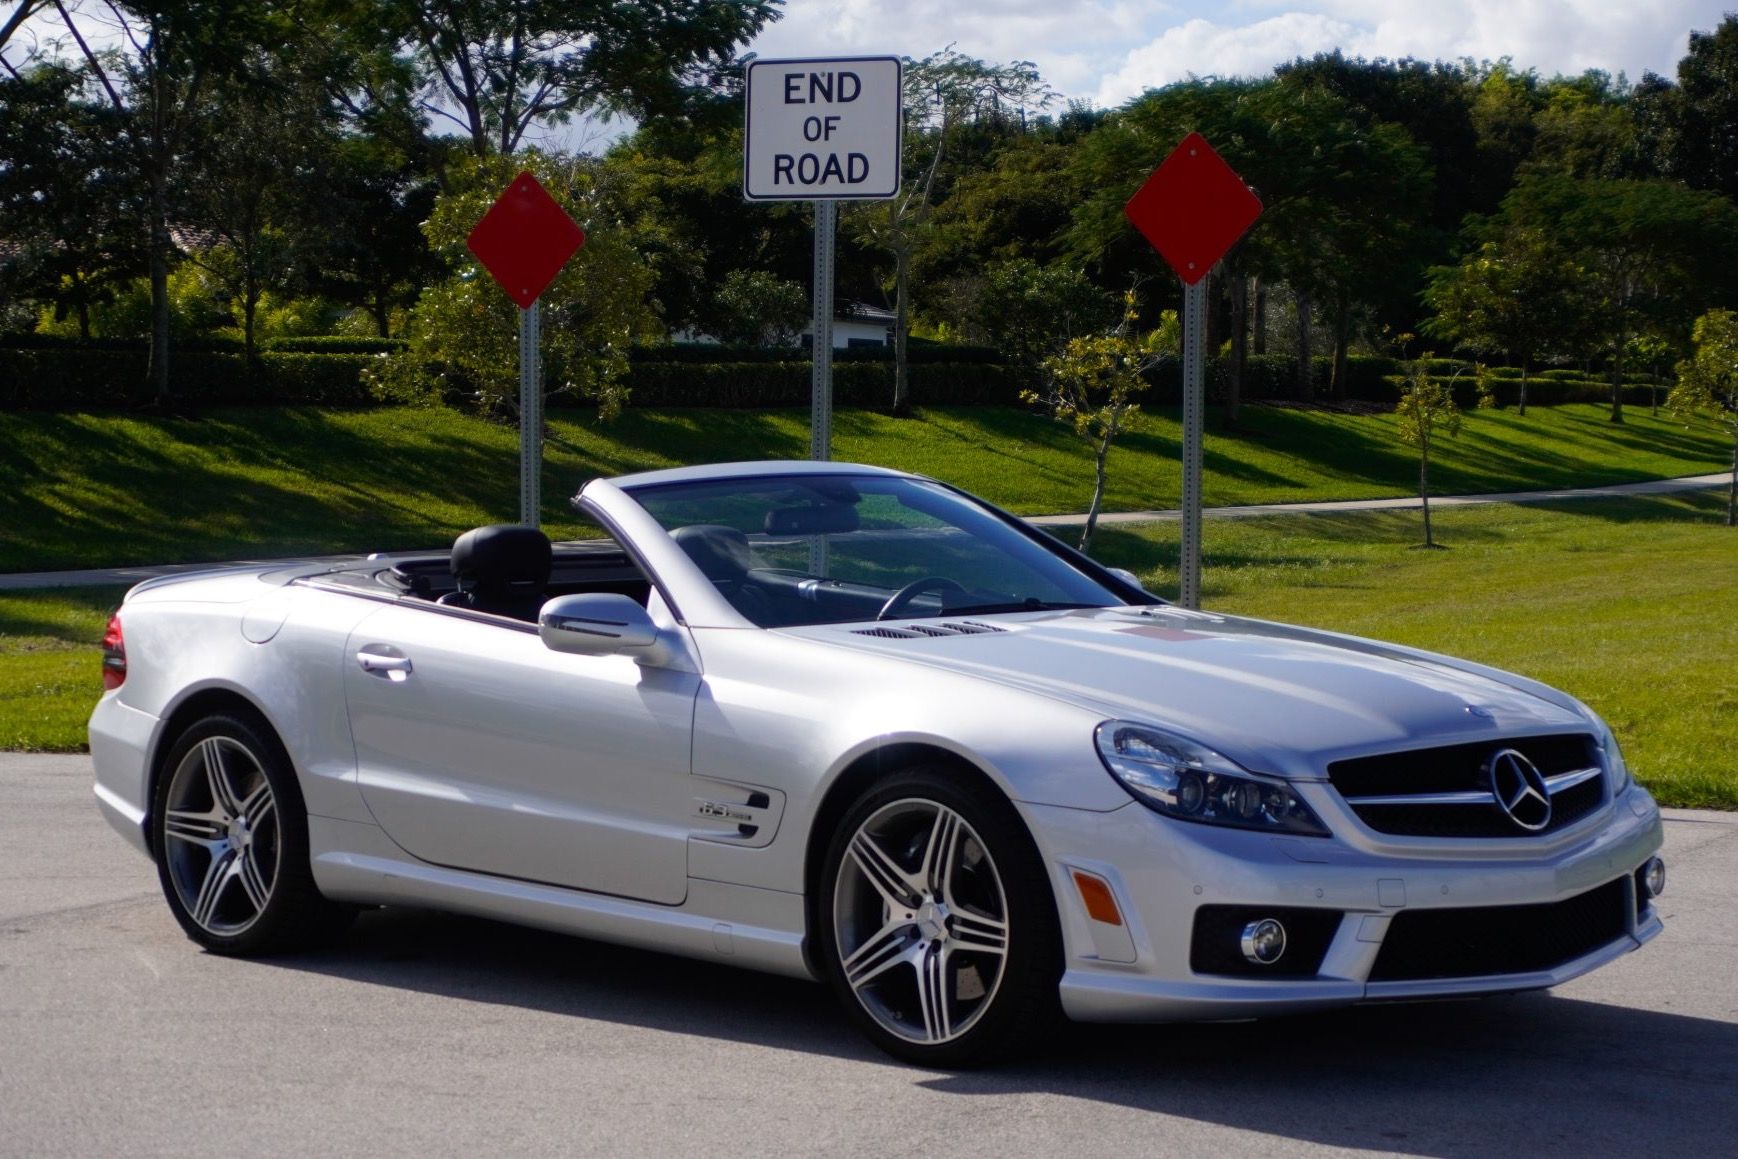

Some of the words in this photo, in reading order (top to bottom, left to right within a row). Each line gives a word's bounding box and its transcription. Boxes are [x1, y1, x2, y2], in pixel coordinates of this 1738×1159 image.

[784, 71, 862, 104] END
[803, 116, 842, 142] OF
[773, 152, 870, 185] ROAD
